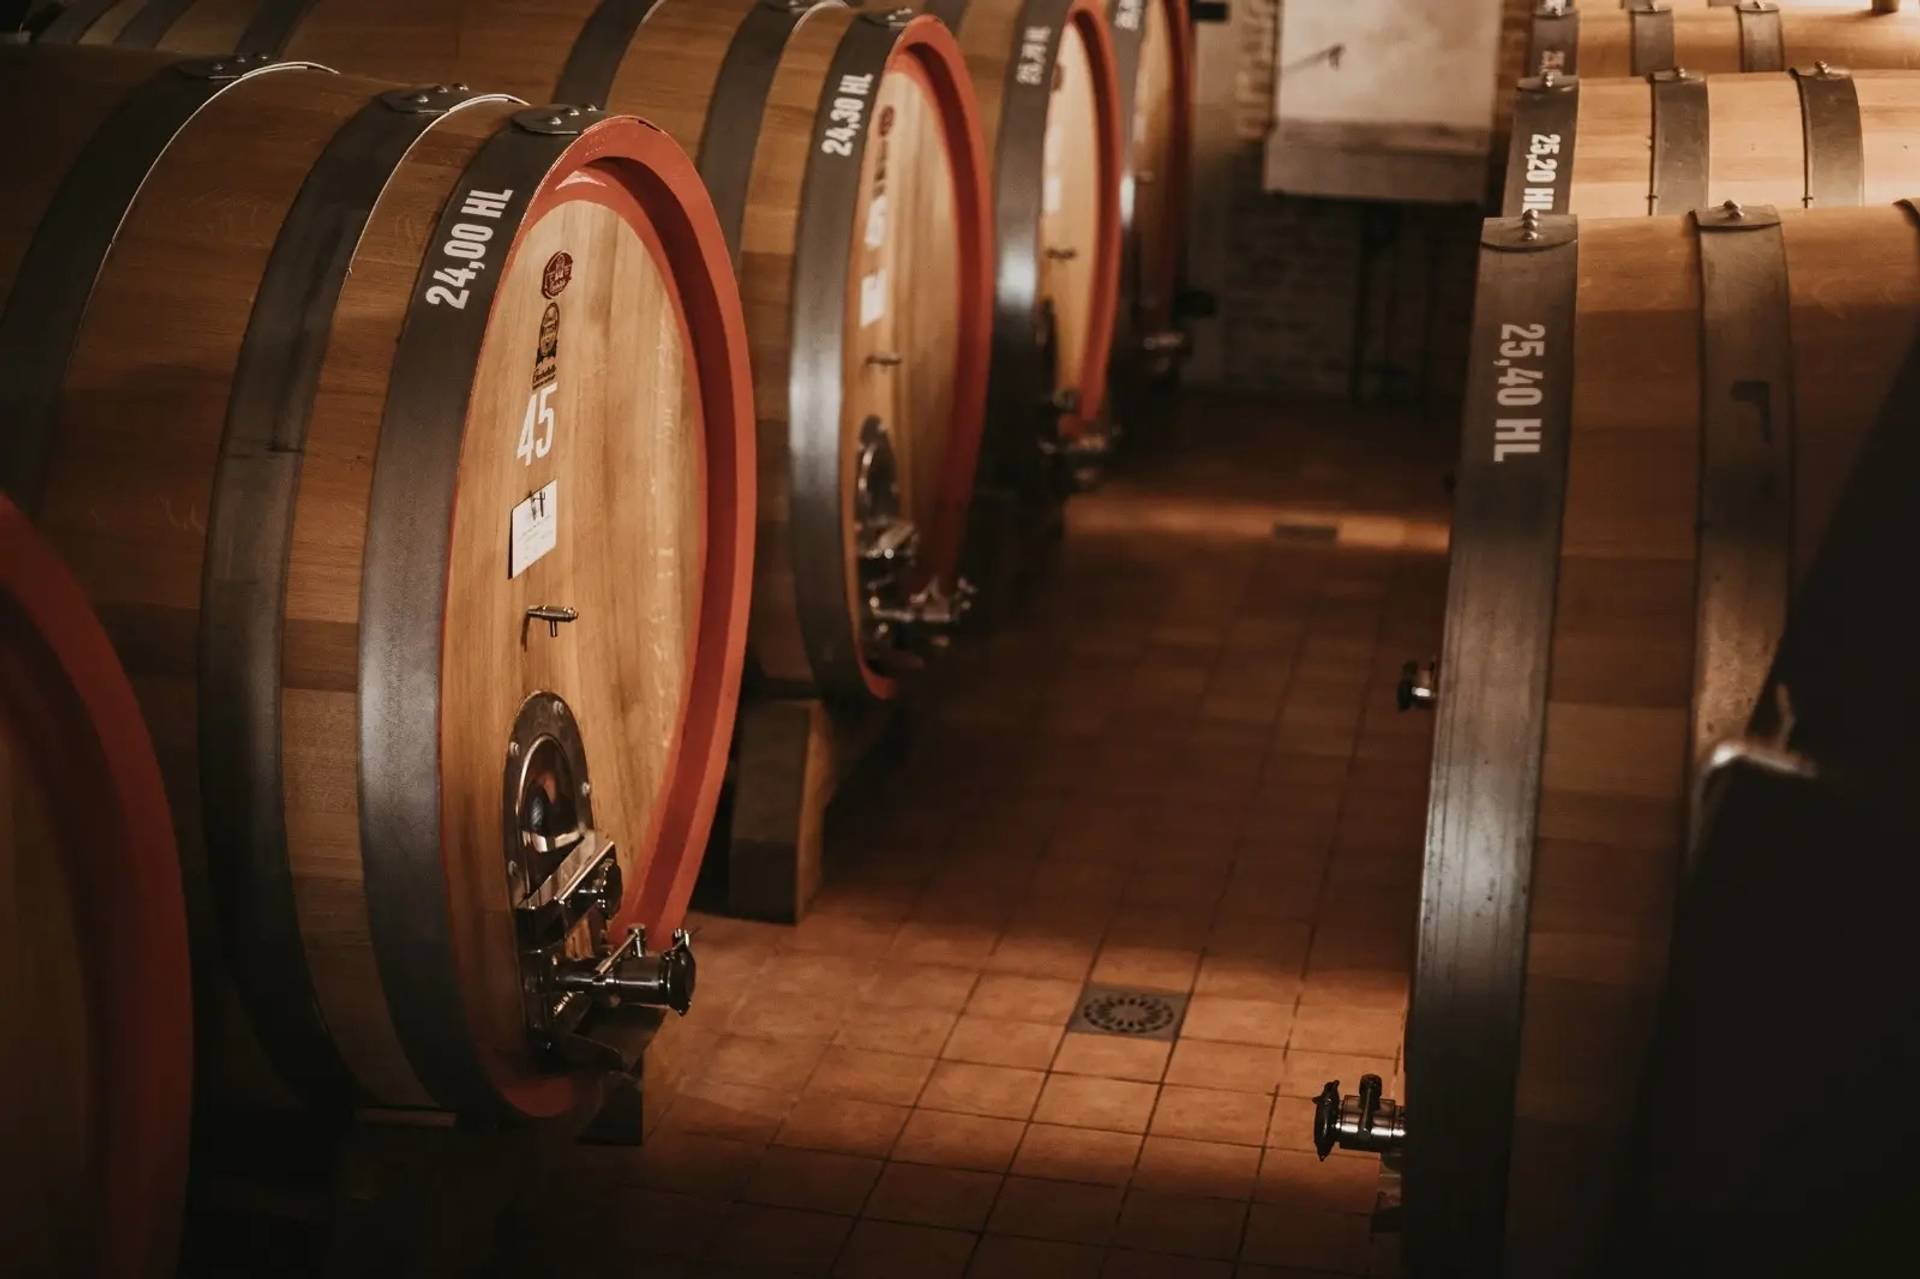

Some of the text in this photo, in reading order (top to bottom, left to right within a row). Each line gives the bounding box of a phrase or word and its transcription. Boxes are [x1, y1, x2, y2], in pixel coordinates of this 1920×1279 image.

[821, 72, 874, 157] 24,30 HL
[1525, 134, 1561, 182] 25,20
[425, 188, 513, 310] 24,00 HL
[516, 382, 557, 466] 45
[1492, 323, 1546, 462] 25,40 HL
